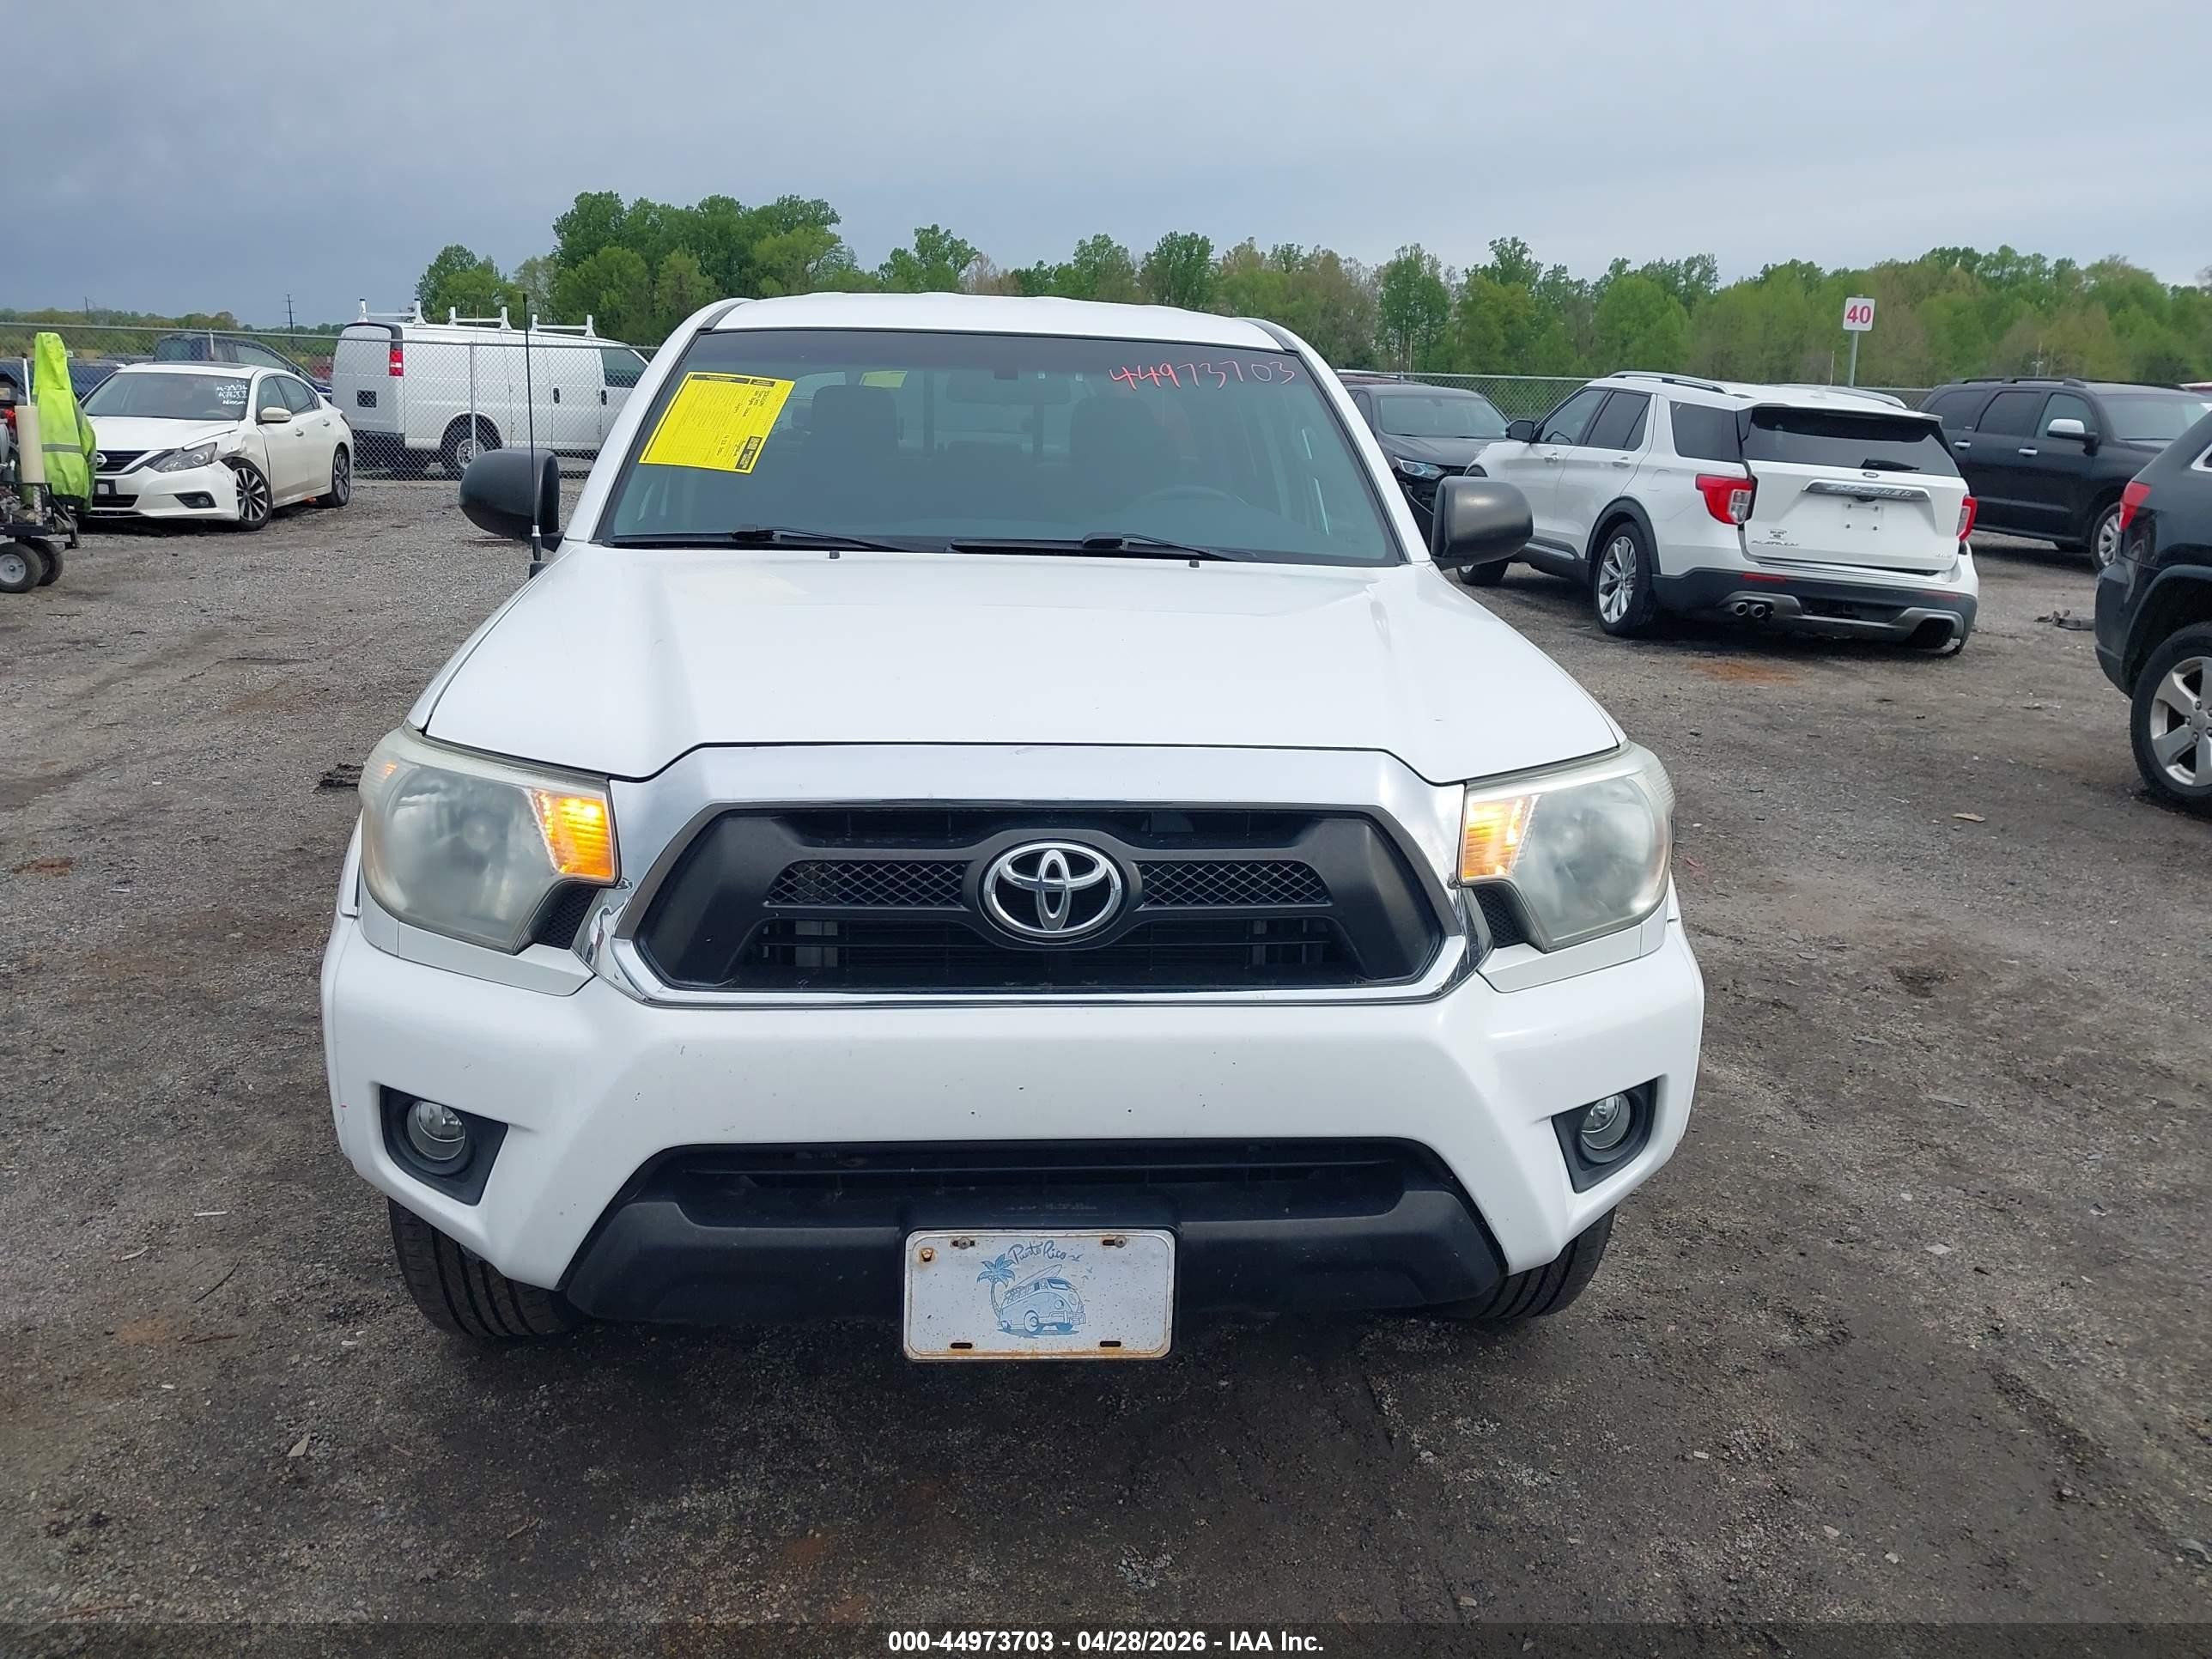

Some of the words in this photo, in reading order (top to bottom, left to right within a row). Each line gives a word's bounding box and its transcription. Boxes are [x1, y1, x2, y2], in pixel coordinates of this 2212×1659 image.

[1846, 305, 1871, 324] 40
[1108, 360, 1296, 391] 44973703
[1826, 484, 1911, 496] EXPLORER
[1007, 1242, 1043, 1265] Puerto
[1043, 1239, 1066, 1260] Rico
